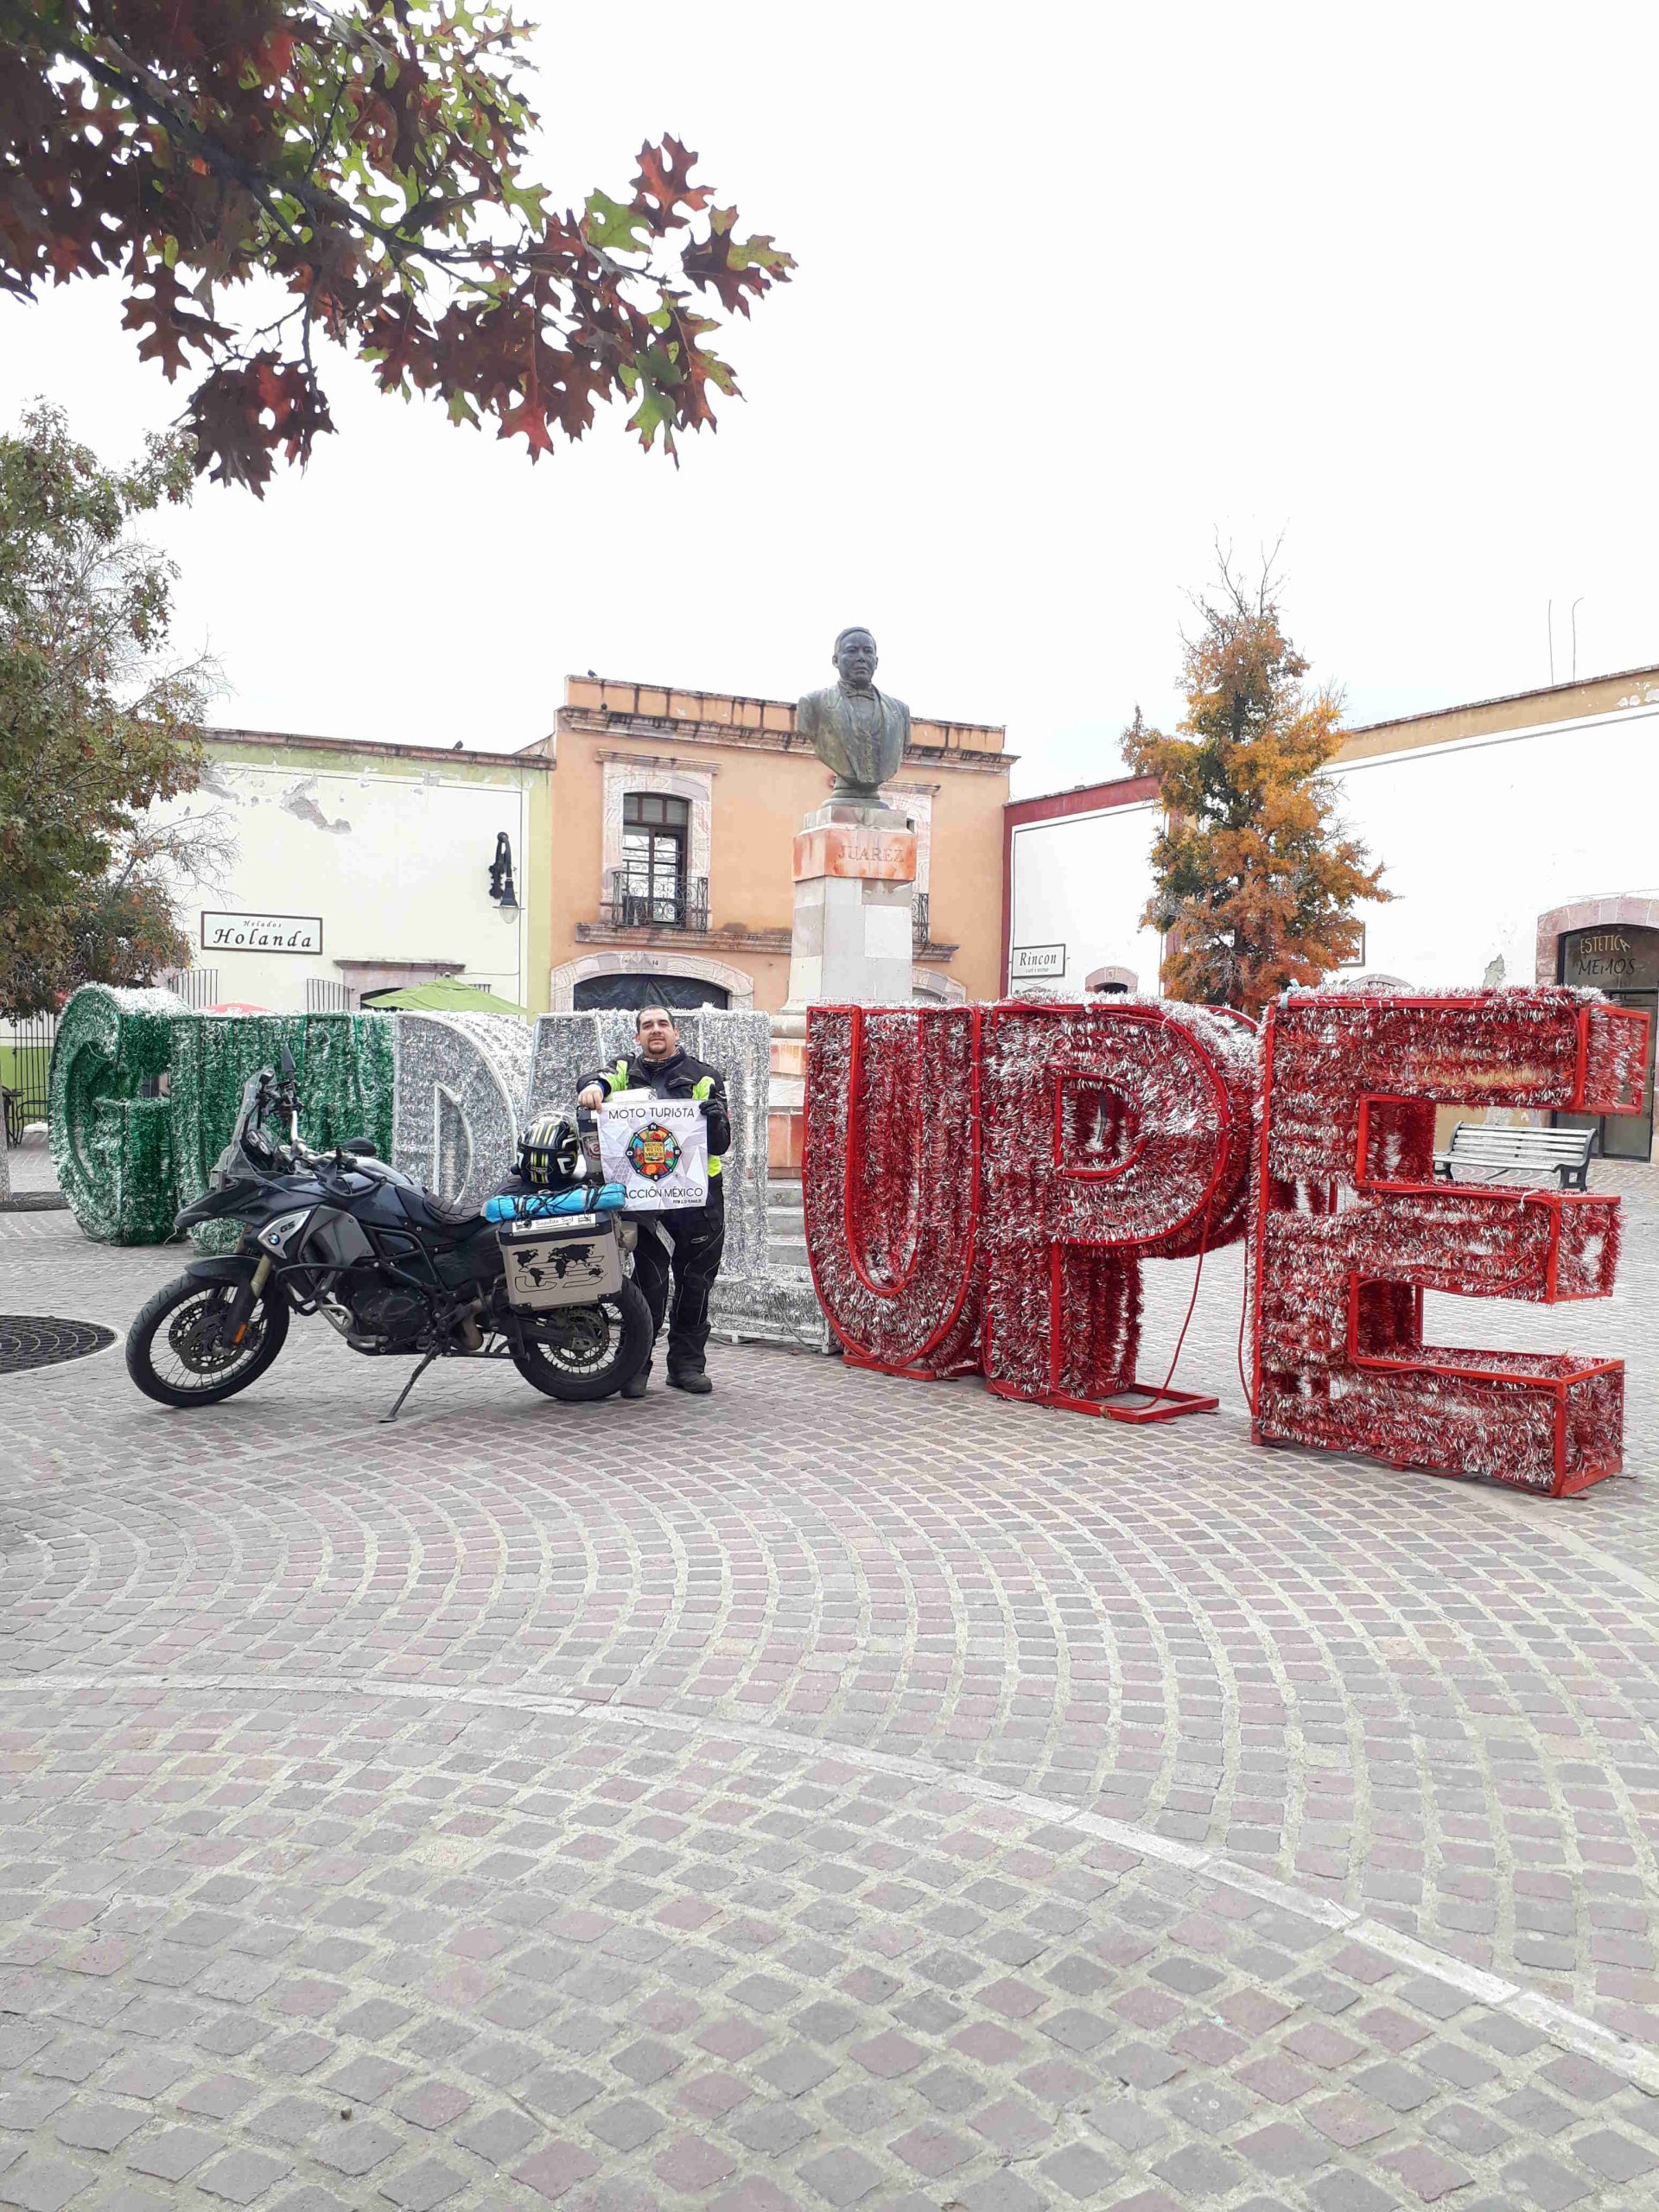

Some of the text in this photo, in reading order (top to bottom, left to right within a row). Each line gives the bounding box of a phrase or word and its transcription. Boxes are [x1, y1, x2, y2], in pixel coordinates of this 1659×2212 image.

[837, 844, 905, 863] JUAREZ
[243, 919, 283, 928] Helados
[213, 928, 312, 948] Holanda
[1580, 934, 1631, 954] ESTETICA
[1020, 951, 1057, 966] Rincon
[1578, 957, 1637, 976] MEMOS
[608, 1107, 695, 1120] MOTO TURISTA
[664, 1185, 703, 1198] MÉXICO
[280, 1221, 296, 1233] GS
